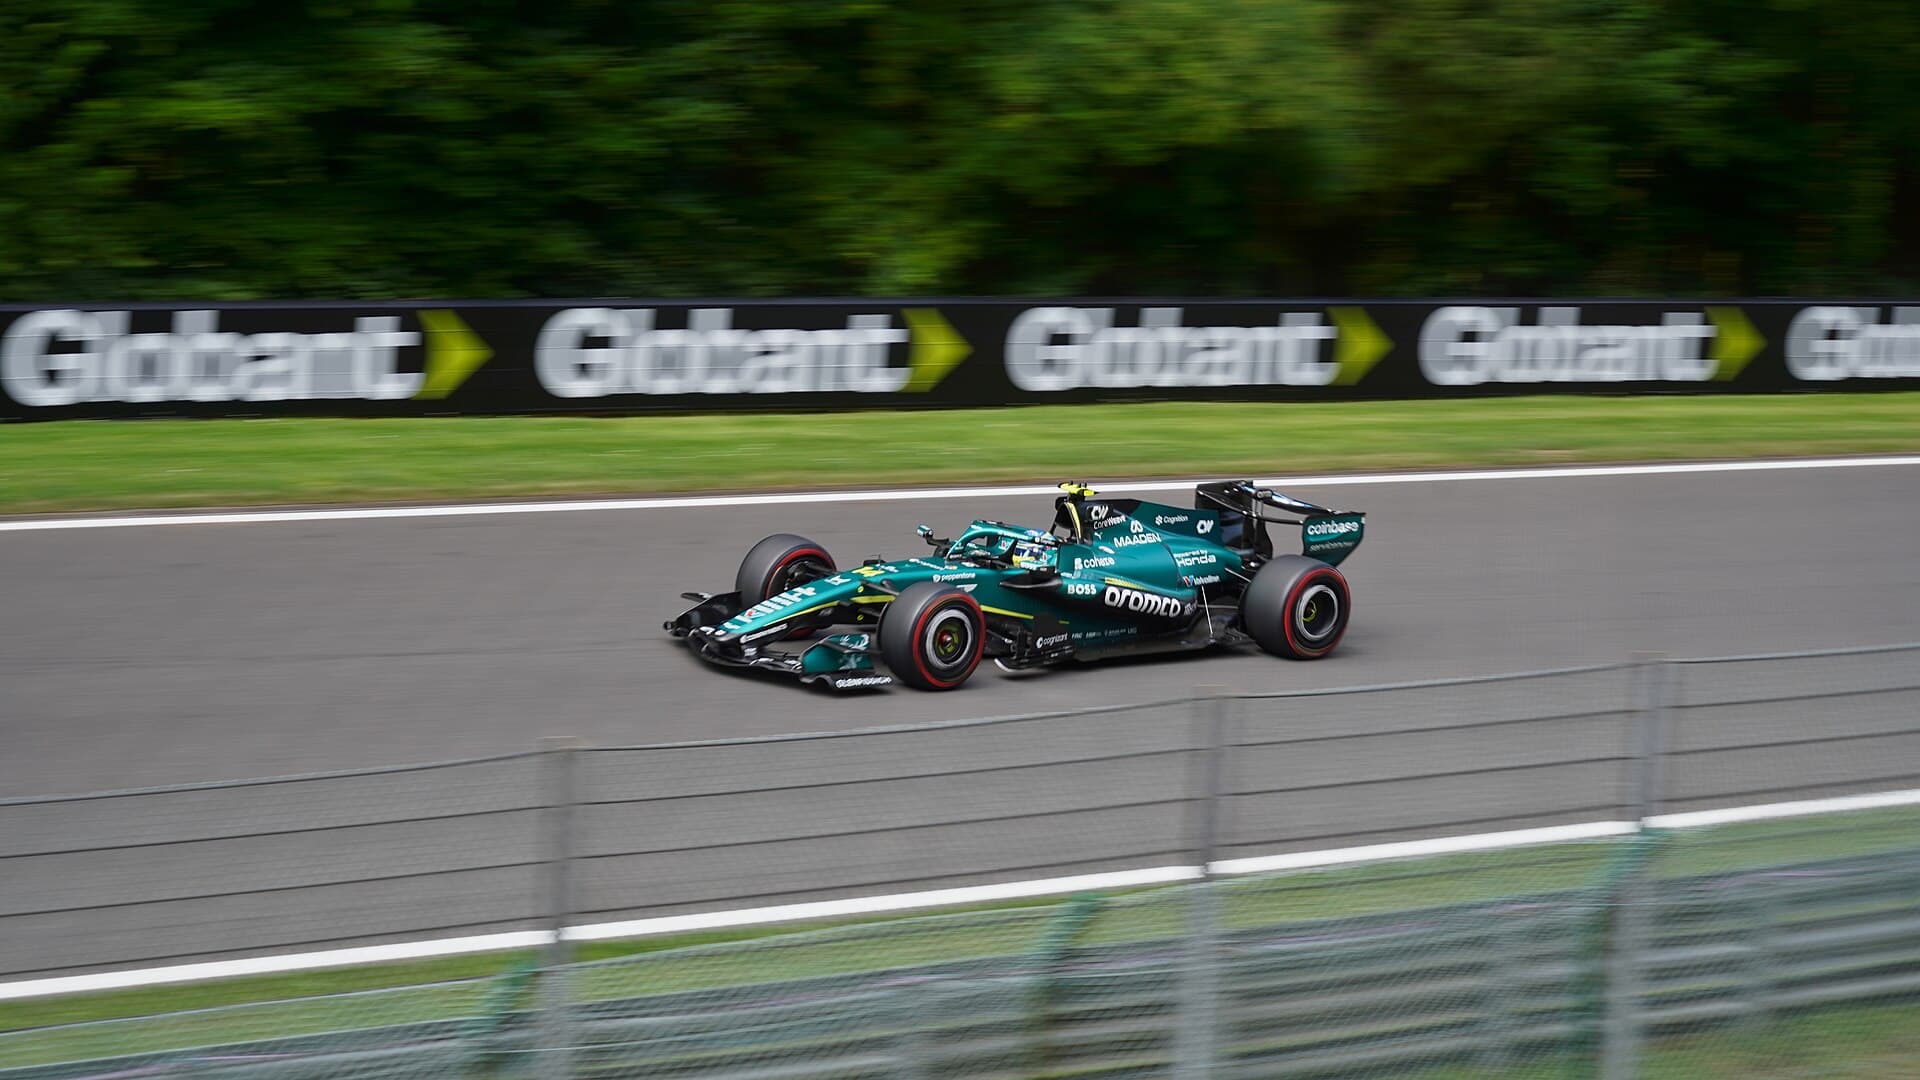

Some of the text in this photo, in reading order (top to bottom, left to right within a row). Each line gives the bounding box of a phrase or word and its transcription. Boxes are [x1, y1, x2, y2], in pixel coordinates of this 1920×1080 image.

[1163, 514, 1189, 524] Cognition
[1307, 520, 1359, 535] coinbase
[1113, 532, 1162, 549] MAADEN
[1175, 554, 1217, 568] Honda
[941, 572, 976, 581] pepperstone
[1067, 583, 1097, 595] BOSS
[1104, 586, 1181, 618] aramco
